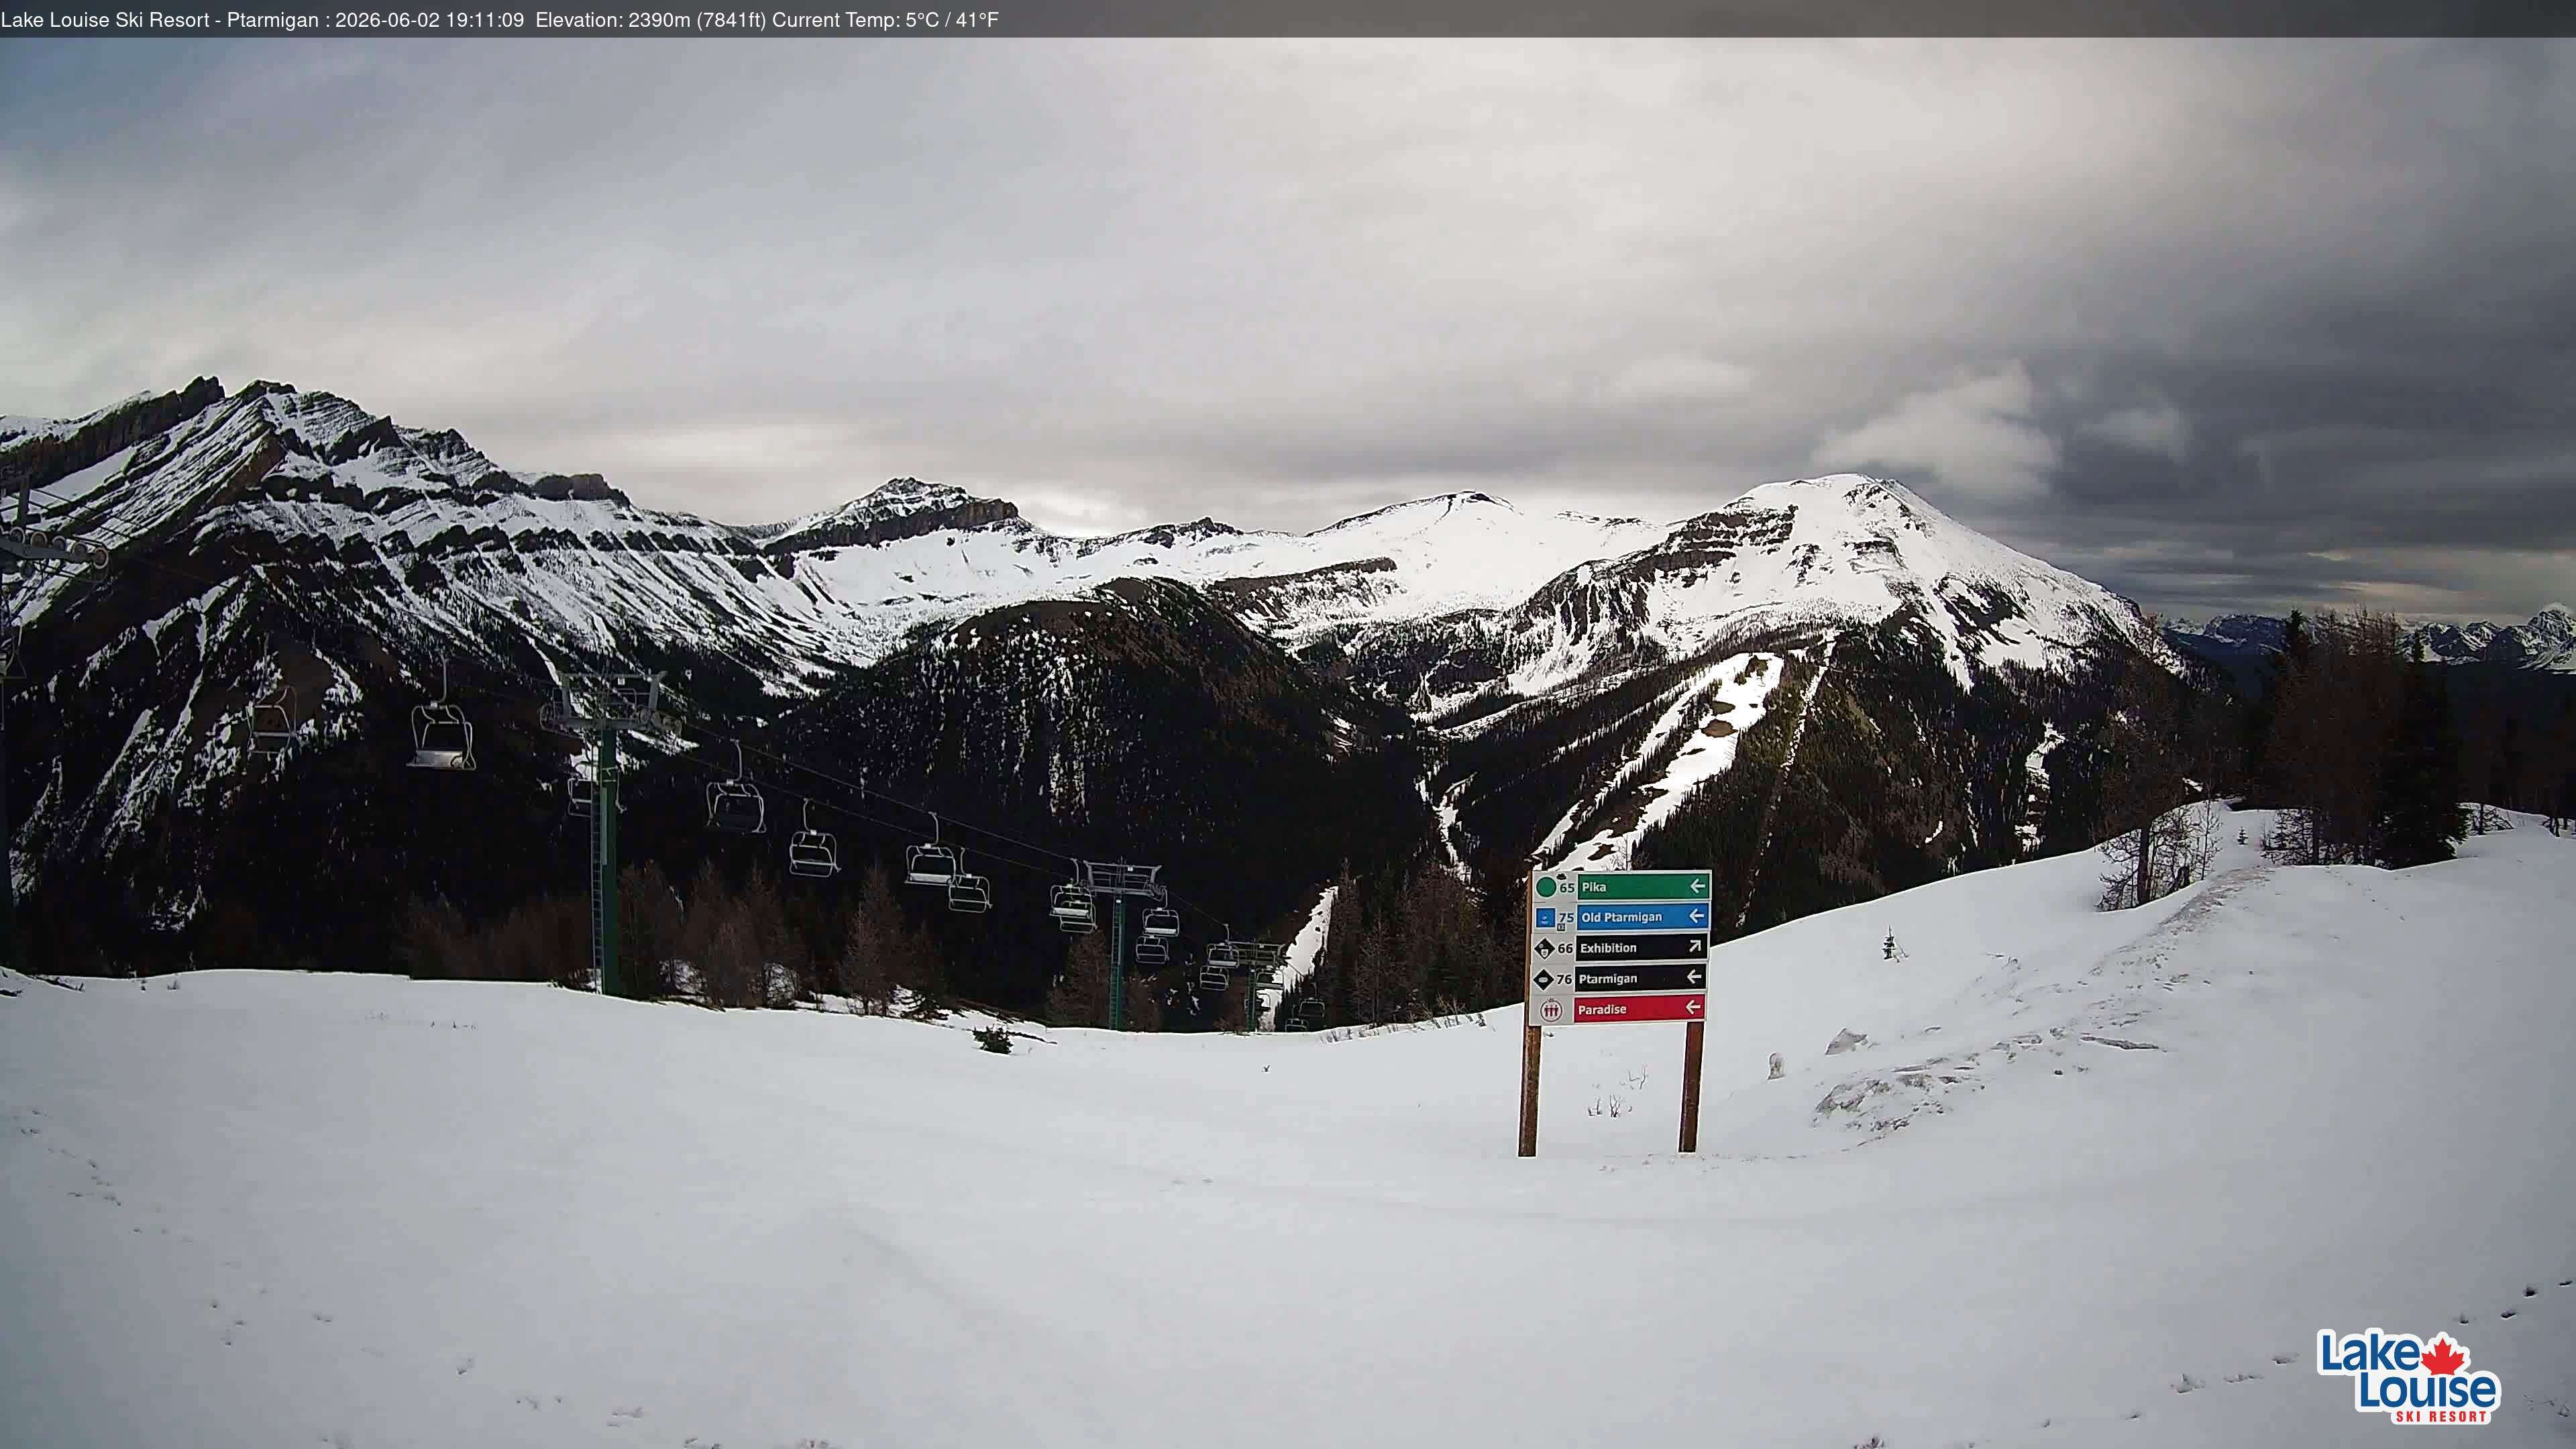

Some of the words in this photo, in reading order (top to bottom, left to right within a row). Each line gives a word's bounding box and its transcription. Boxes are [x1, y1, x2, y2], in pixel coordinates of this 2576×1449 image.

[1560, 883, 1575, 893] 65
[1582, 882, 1607, 892] Pika
[1559, 913, 1574, 923] 75
[1581, 912, 1601, 922] Old
[1605, 912, 1662, 924] Ptarmigan
[1558, 944, 1573, 954] 66
[1580, 943, 1637, 953] Exhibition
[1556, 975, 1572, 985] 76
[1579, 974, 1638, 985] Ptarmigan
[1578, 1004, 1627, 1015] Paradise
